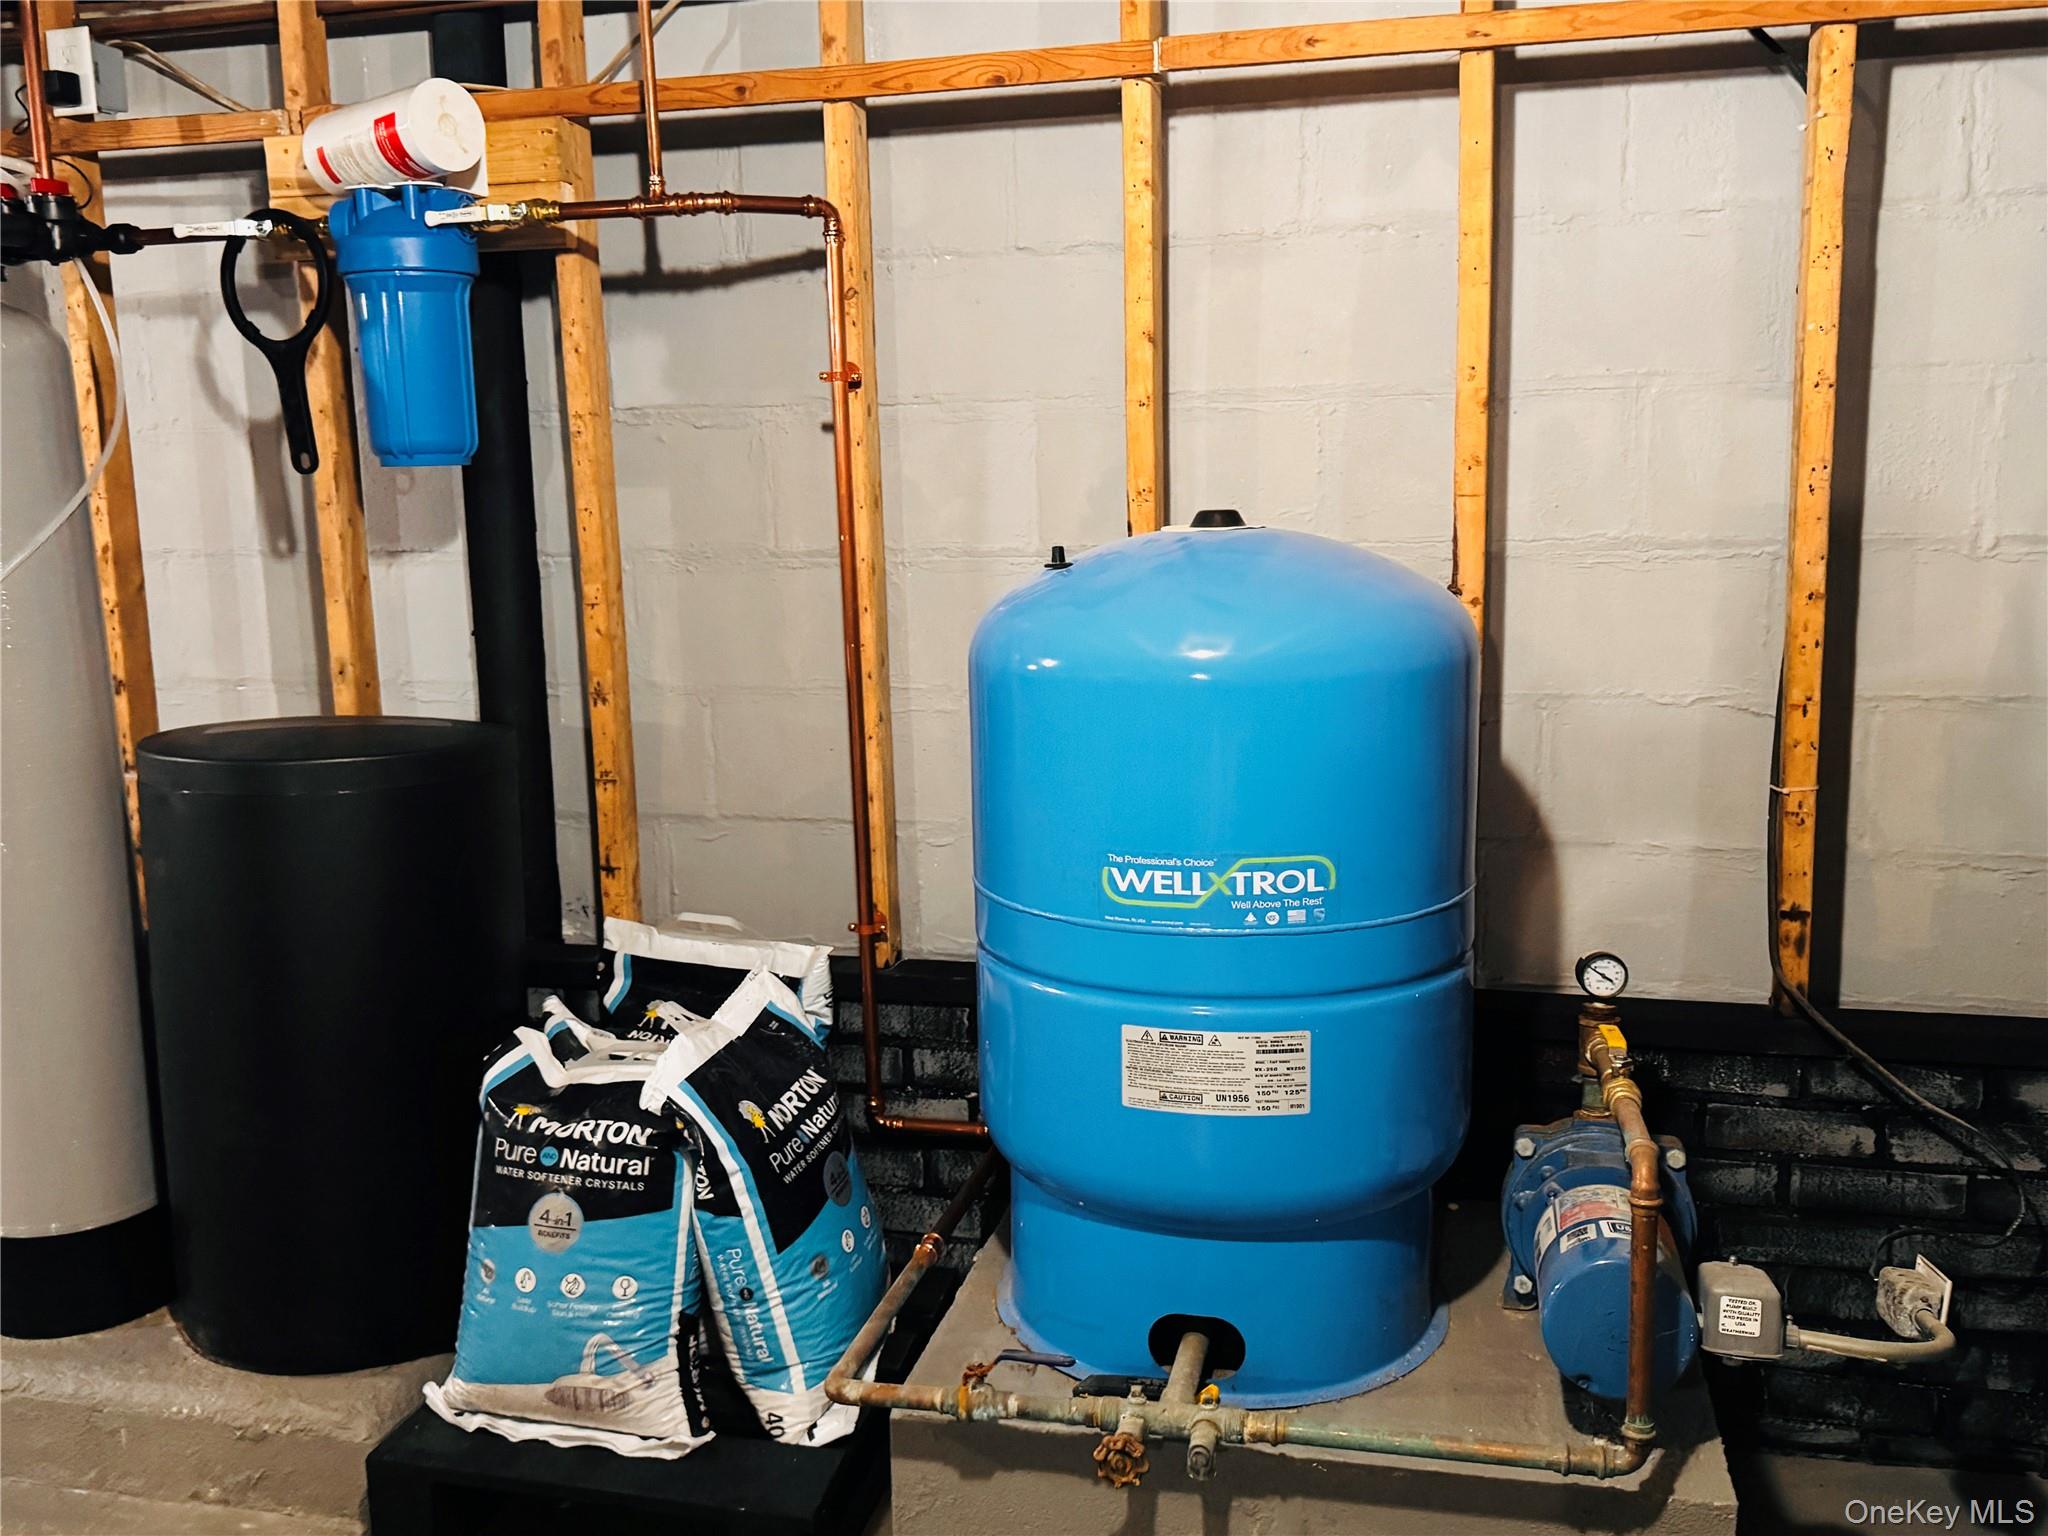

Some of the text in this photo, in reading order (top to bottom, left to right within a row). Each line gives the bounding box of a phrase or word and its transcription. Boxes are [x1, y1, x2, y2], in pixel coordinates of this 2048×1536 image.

[1107, 853, 1123, 863] The
[1183, 858, 1214, 867] Choice
[1231, 897, 1323, 909] Well Above The Rest
[1169, 1034, 1201, 1043] WARNING
[1168, 1093, 1200, 1102] CAUTION
[1215, 1093, 1250, 1103] UN1956
[529, 1115, 654, 1147] MORTON
[494, 1137, 537, 1164] Pure
[559, 1147, 650, 1177] Natural
[769, 1137, 804, 1174] Pure
[495, 1165, 646, 1192] WATER SOFTENER CRYSTALS
[783, 1159, 807, 1184] WATER
[726, 1248, 748, 1288] Pure
[743, 1302, 775, 1363] Natural
[765, 1412, 785, 1439] 40
